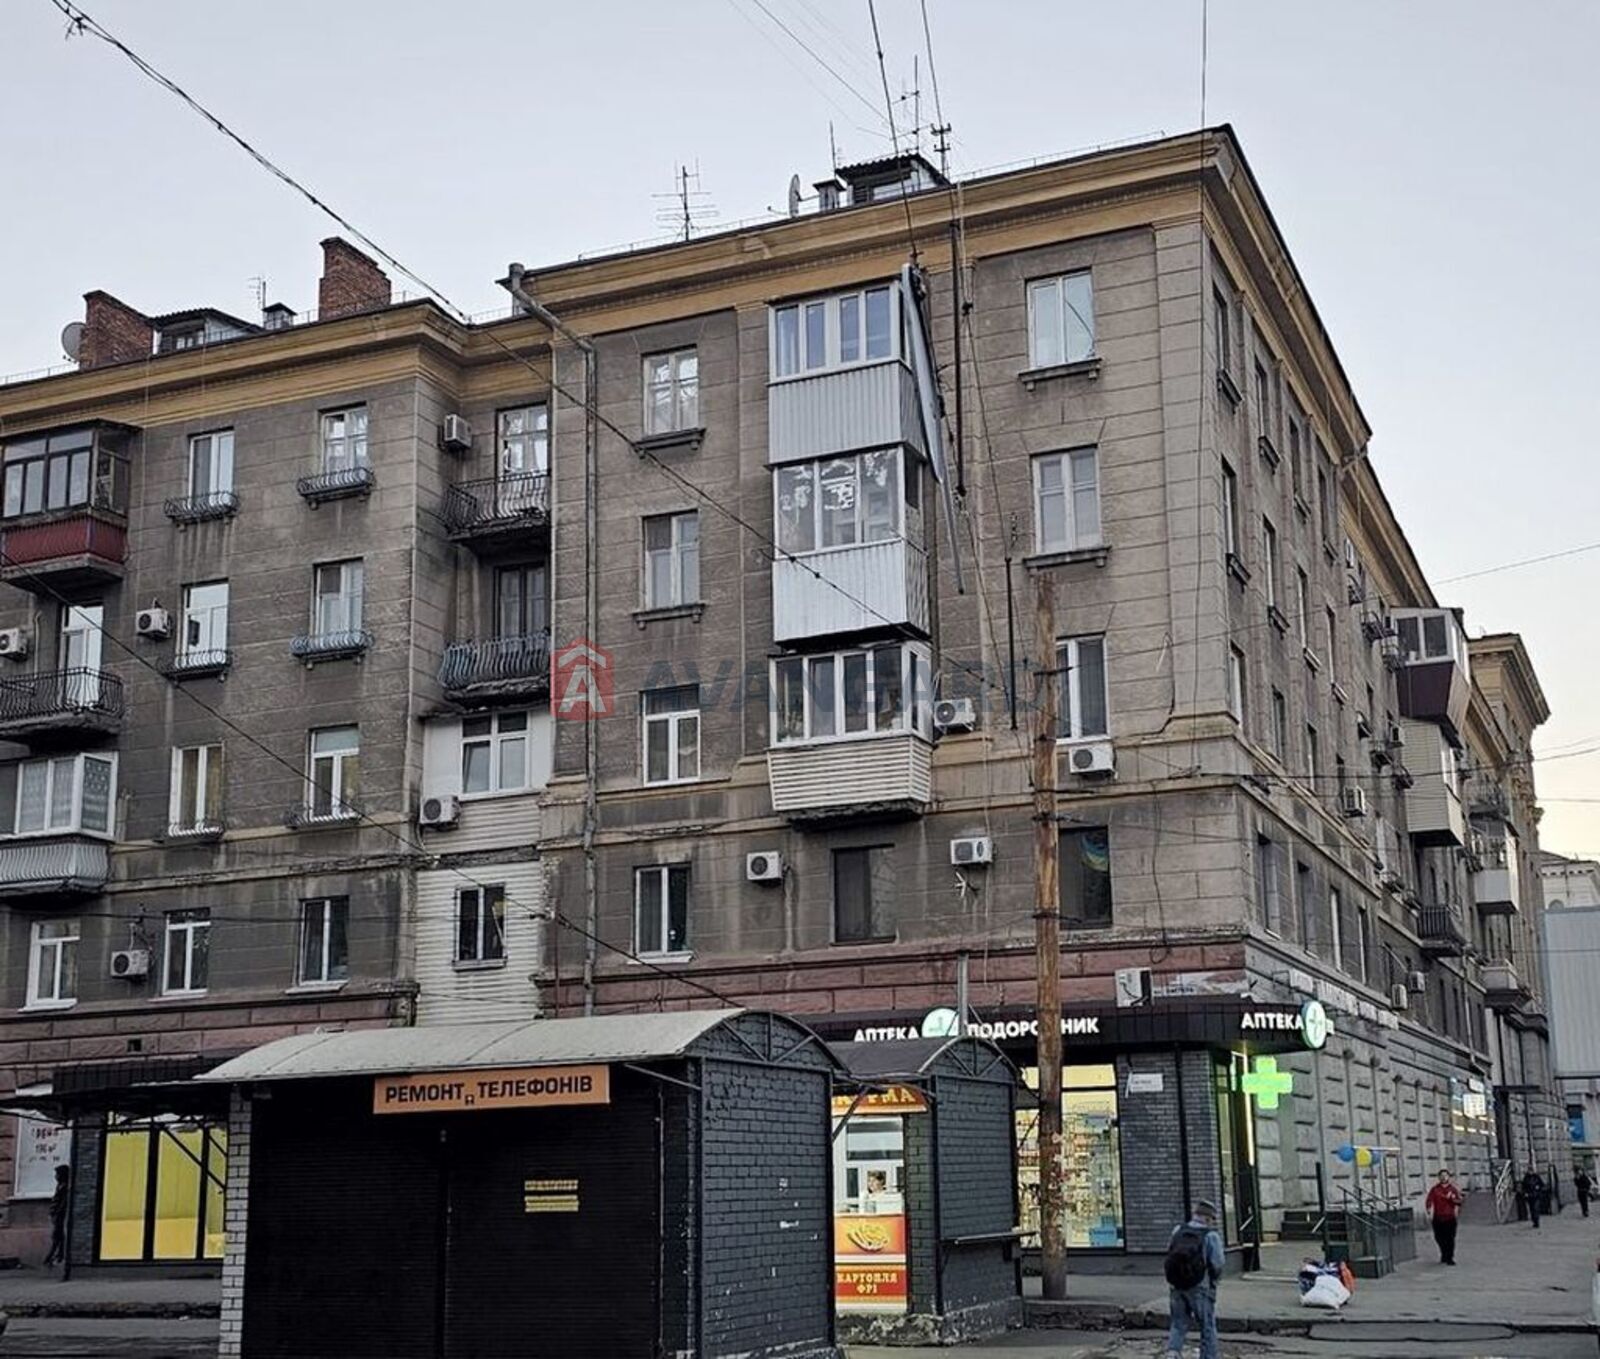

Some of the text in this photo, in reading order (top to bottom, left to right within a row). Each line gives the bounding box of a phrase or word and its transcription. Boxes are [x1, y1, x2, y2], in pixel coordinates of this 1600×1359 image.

[854, 1017, 1099, 1042] АПТЕКА ПОДОРОНИК
[1241, 1013, 1305, 1030] АПТЕКА
[385, 1076, 592, 1103] РЕМОНТ ТЕЛЕФОНІВ
